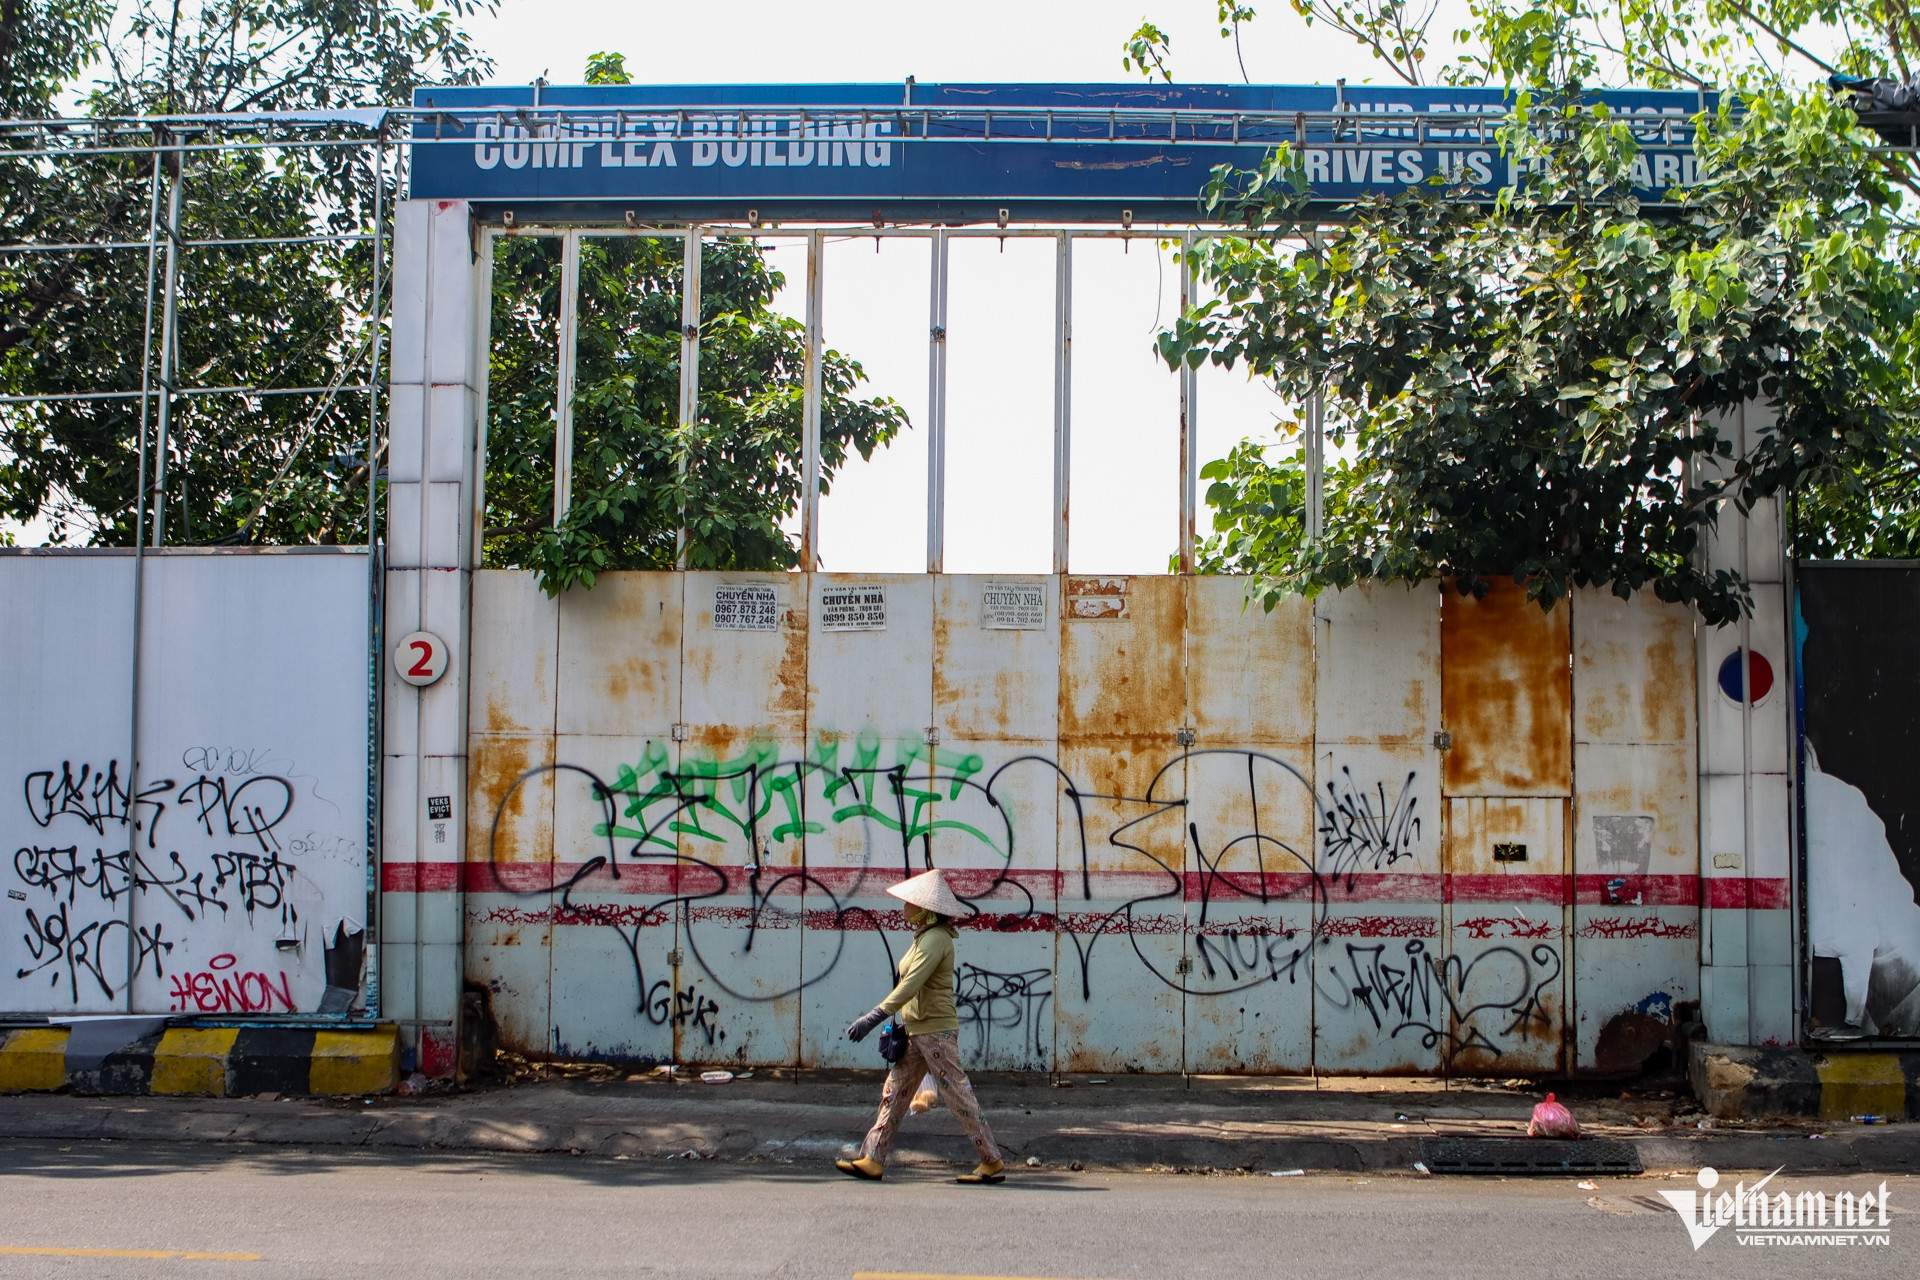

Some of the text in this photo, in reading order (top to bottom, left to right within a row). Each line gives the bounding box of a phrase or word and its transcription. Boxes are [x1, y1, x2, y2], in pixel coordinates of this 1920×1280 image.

[473, 114, 892, 170] COMPLEX BUILDING
[1438, 151, 1493, 185] US
[716, 588, 776, 601] CHUYỂN NHÀ
[822, 590, 884, 605] CHUYỂN NHÀ
[983, 590, 1043, 606] CHUYỂN NHÀ
[715, 604, 776, 614] 0967.878.246
[714, 614, 776, 624] 0907.767.246
[823, 611, 885, 622] 0899 850 850
[407, 640, 433, 676] 2
[429, 805, 450, 814] EVICT
